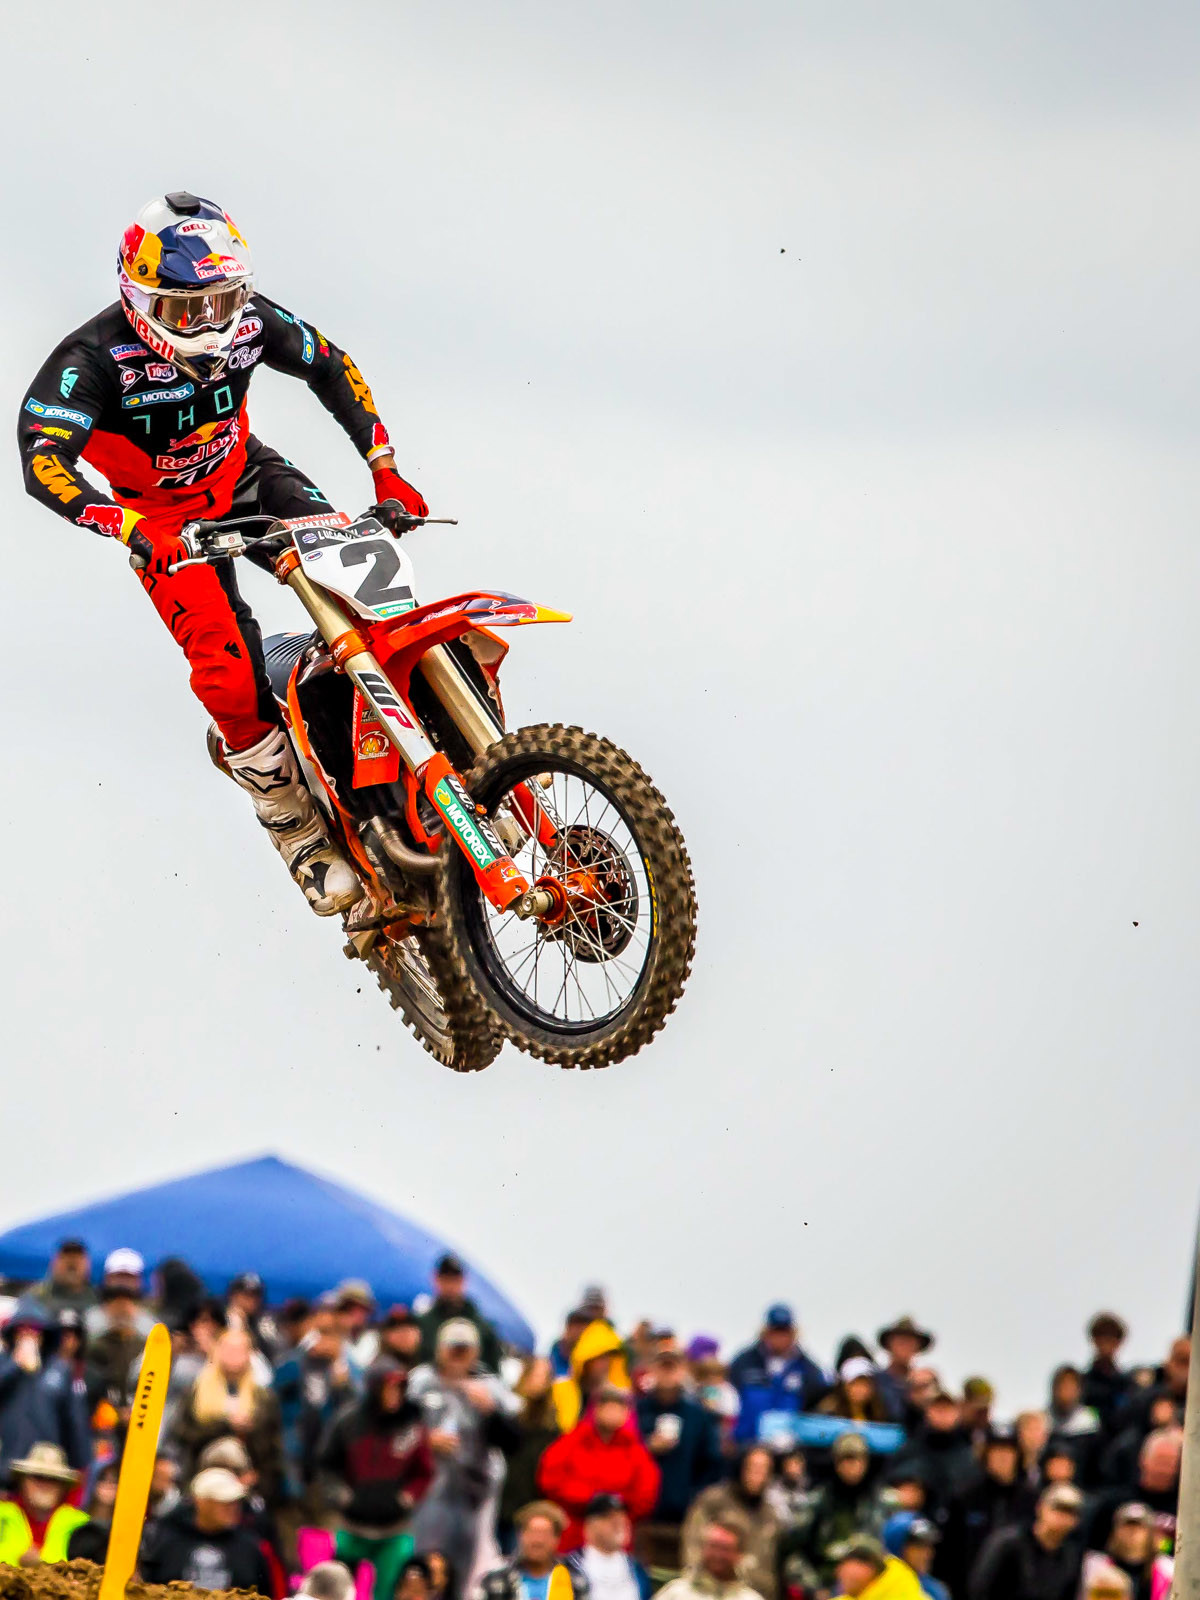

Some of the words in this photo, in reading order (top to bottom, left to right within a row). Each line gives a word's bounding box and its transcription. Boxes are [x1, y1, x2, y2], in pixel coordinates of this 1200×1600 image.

[182, 223, 208, 233] BELL
[197, 266, 222, 278] Red
[223, 263, 246, 273] Bull
[136, 316, 175, 362] Bull
[142, 387, 190, 403] MOTOREX
[44, 408, 87, 425] MOTOREX
[156, 444, 206, 470] Red
[32, 454, 83, 504] KTM
[339, 539, 412, 606] 2
[445, 803, 491, 865] MOTOREX
[448, 778, 507, 856] DUOP
